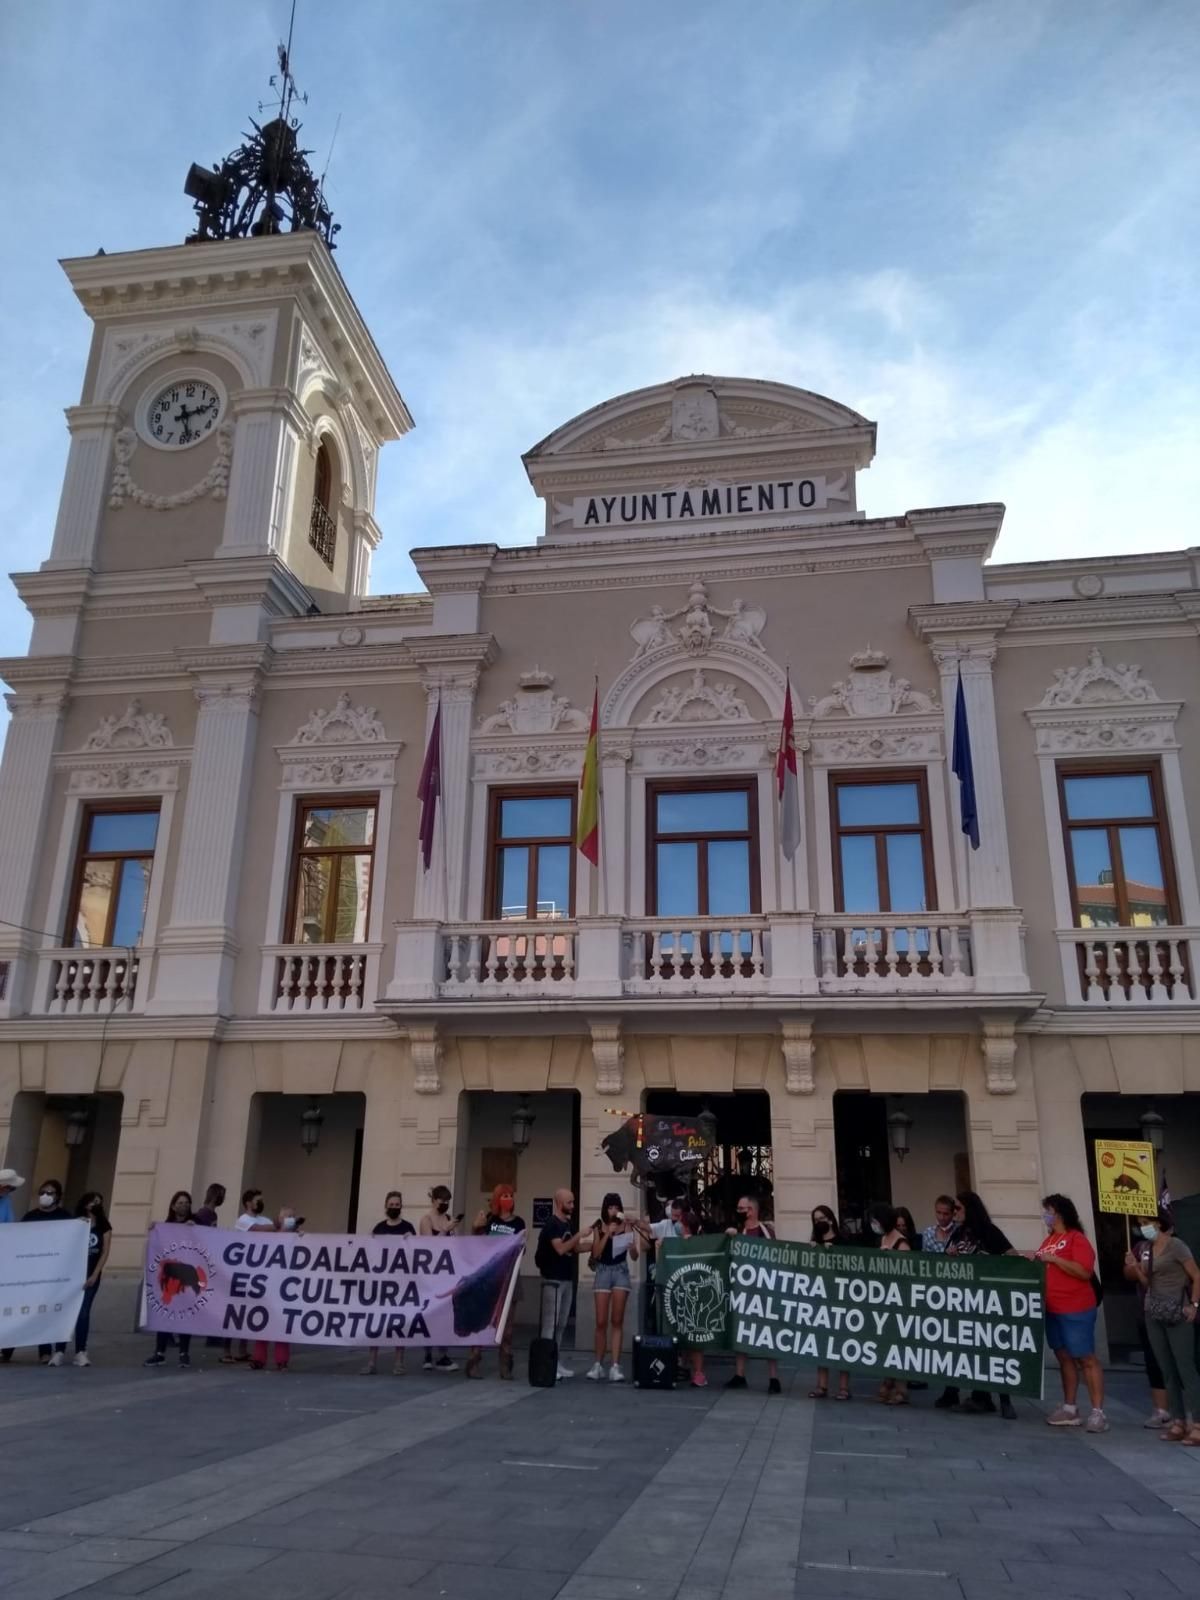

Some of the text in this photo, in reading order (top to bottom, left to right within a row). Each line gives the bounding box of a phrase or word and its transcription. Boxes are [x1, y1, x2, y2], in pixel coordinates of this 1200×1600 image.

[172, 391, 179, 402] 11
[186, 387, 195, 397] 12
[202, 389, 206, 400] 1
[161, 402, 170, 412] 10
[209, 397, 216, 407] 2
[154, 413, 161, 423] 9
[212, 408, 218, 419] 3
[156, 425, 163, 435] 8
[205, 420, 211, 429] 4
[166, 432, 174, 443] 7
[179, 434, 185, 444] 6
[193, 430, 200, 440] 5
[584, 479, 816, 525] AYUNTAMIENTO
[1114, 1194, 1154, 1203] TORTURA
[1115, 1207, 1156, 1215] CULTURA
[1131, 1202, 1155, 1210] ARTE
[223, 1242, 455, 1276] GUADALAJARA
[801, 1251, 815, 1268] DE
[818, 1252, 865, 1273] DEFENSA
[868, 1256, 917, 1279] ANIMAL
[919, 1261, 932, 1279] EL
[935, 1262, 974, 1281] CASAR
[230, 1272, 430, 1311] ES CULTURA,
[729, 1264, 1042, 1319] CONTRA TODA FORMA DE
[223, 1304, 430, 1339] NO TORTURA
[729, 1292, 1037, 1353] MALTRATO Y VIOLENCIA
[736, 1323, 1021, 1386] HACIA LOS ANIMALES
